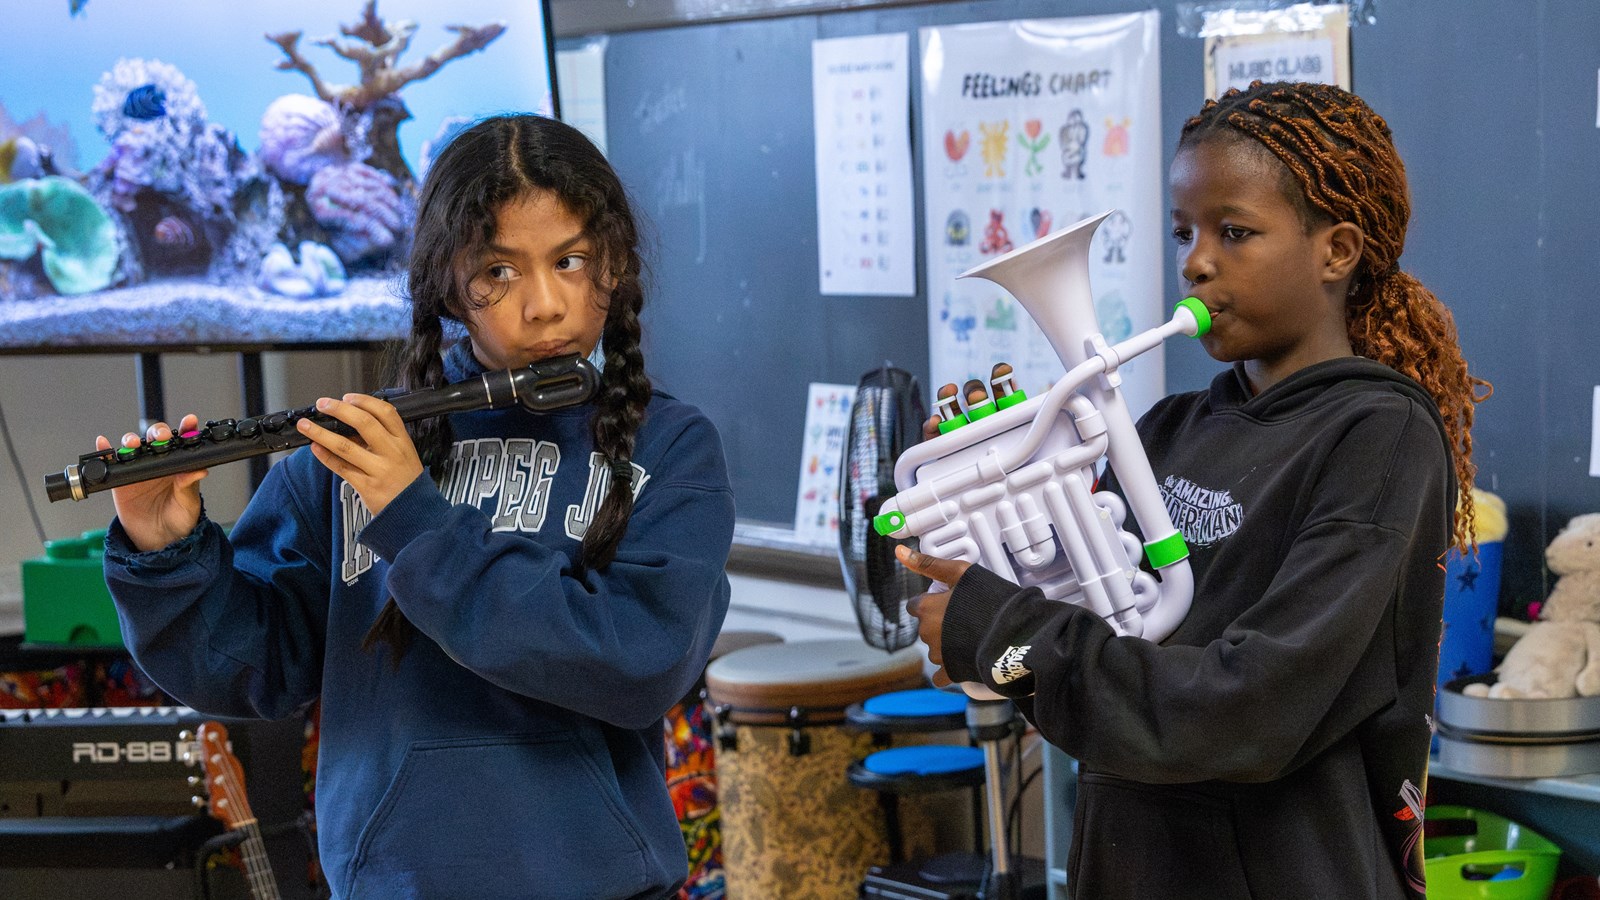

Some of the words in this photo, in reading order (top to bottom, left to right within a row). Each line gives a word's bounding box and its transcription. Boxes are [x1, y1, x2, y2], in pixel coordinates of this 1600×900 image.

[1049, 69, 1112, 96] CHART
[1172, 478, 1233, 509] AMAZING
[73, 742, 171, 763] RD-88
